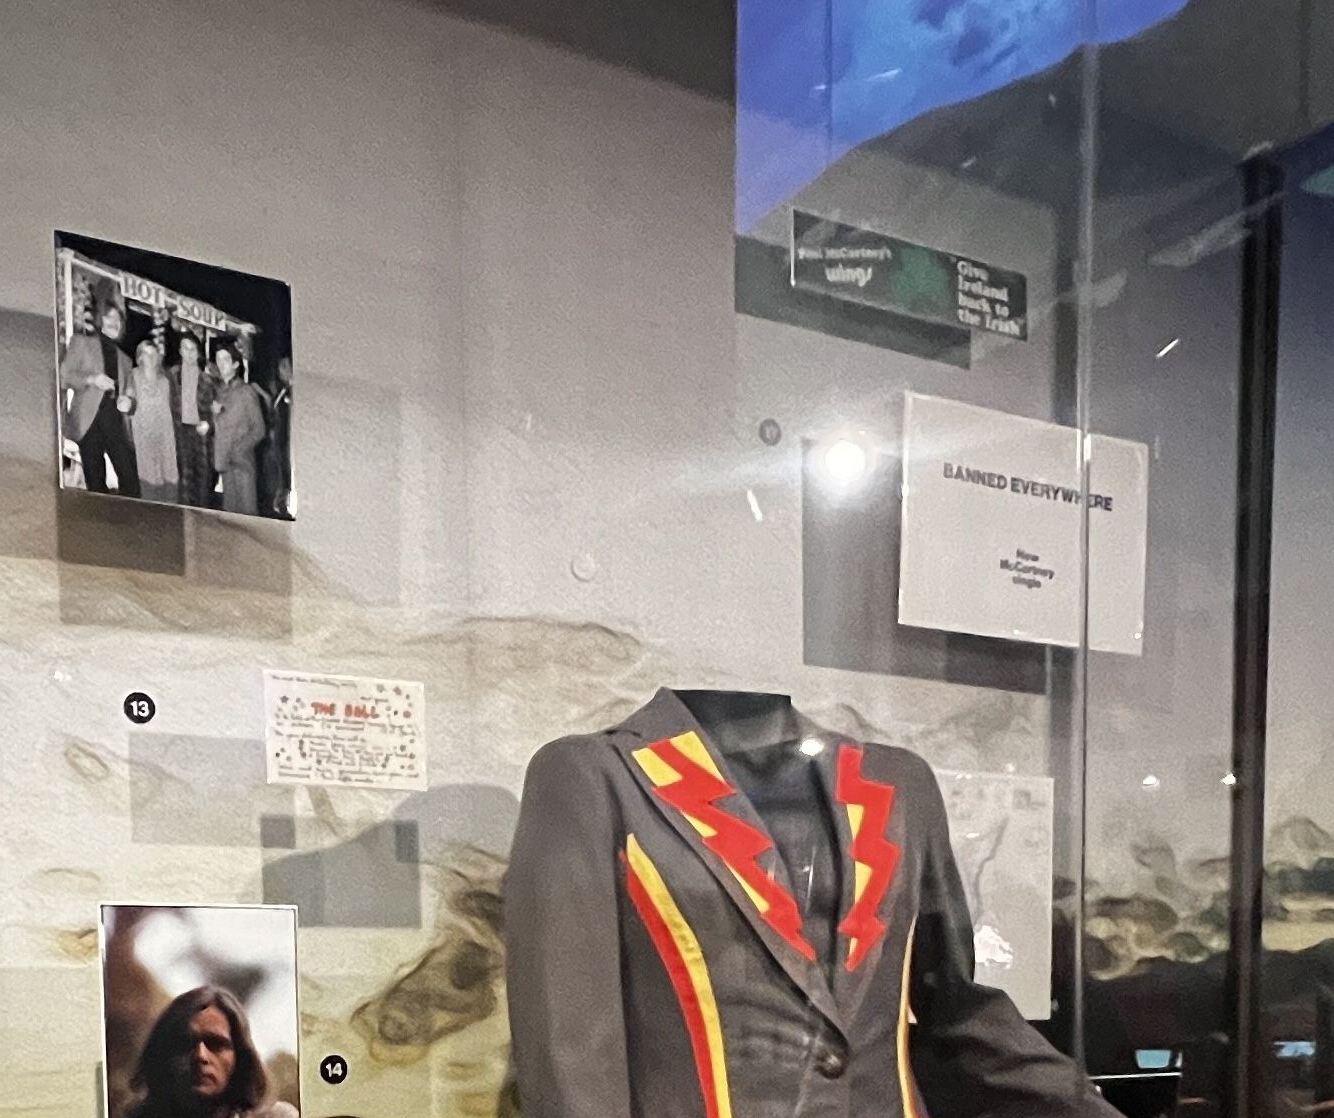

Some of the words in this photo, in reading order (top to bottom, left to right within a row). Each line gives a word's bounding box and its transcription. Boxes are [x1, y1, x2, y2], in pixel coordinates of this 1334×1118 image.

[122, 276, 161, 304] HOT
[179, 300, 224, 328] SOUP
[943, 462, 1008, 491] BANNED
[130, 700, 150, 717] 13
[326, 1063, 343, 1077] 14
